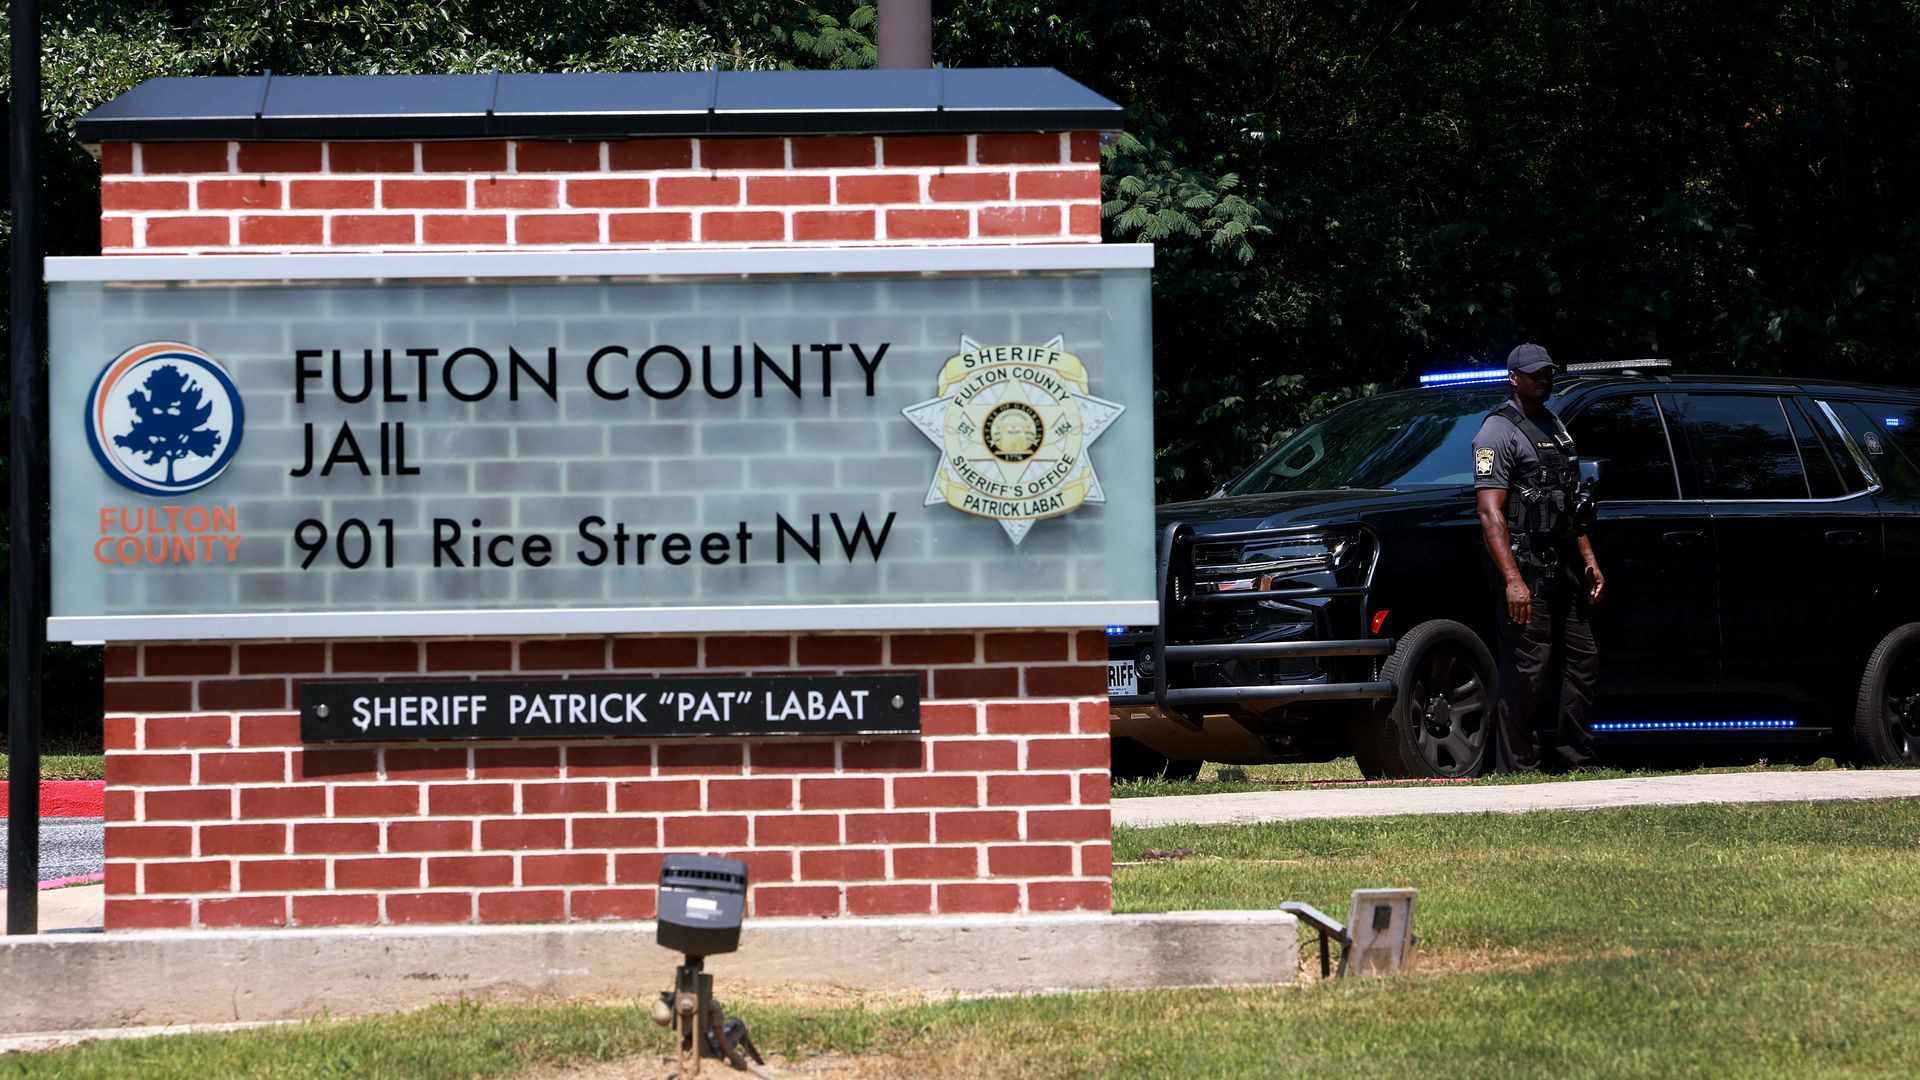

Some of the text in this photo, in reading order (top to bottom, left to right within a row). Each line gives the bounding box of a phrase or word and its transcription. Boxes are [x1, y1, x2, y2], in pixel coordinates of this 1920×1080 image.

[963, 347, 1061, 368] SHERIFF
[295, 342, 890, 404] FULTON COUNTY
[954, 367, 1071, 408] FULTON COUNTY
[957, 422, 975, 438] EST.
[1055, 422, 1073, 438] 1854
[289, 420, 420, 477] JAIL
[952, 453, 1074, 497] SHERIFF'S OFFICE
[963, 492, 1065, 517] PATRICK LABAT
[99, 506, 237, 534] FULTON
[93, 535, 243, 565] COUNTY
[294, 511, 897, 570] 901 Rice Street NW
[1108, 665, 1133, 686] RIFF
[352, 690, 869, 728] SHERIFF PATRICK “PAT” LABAT
